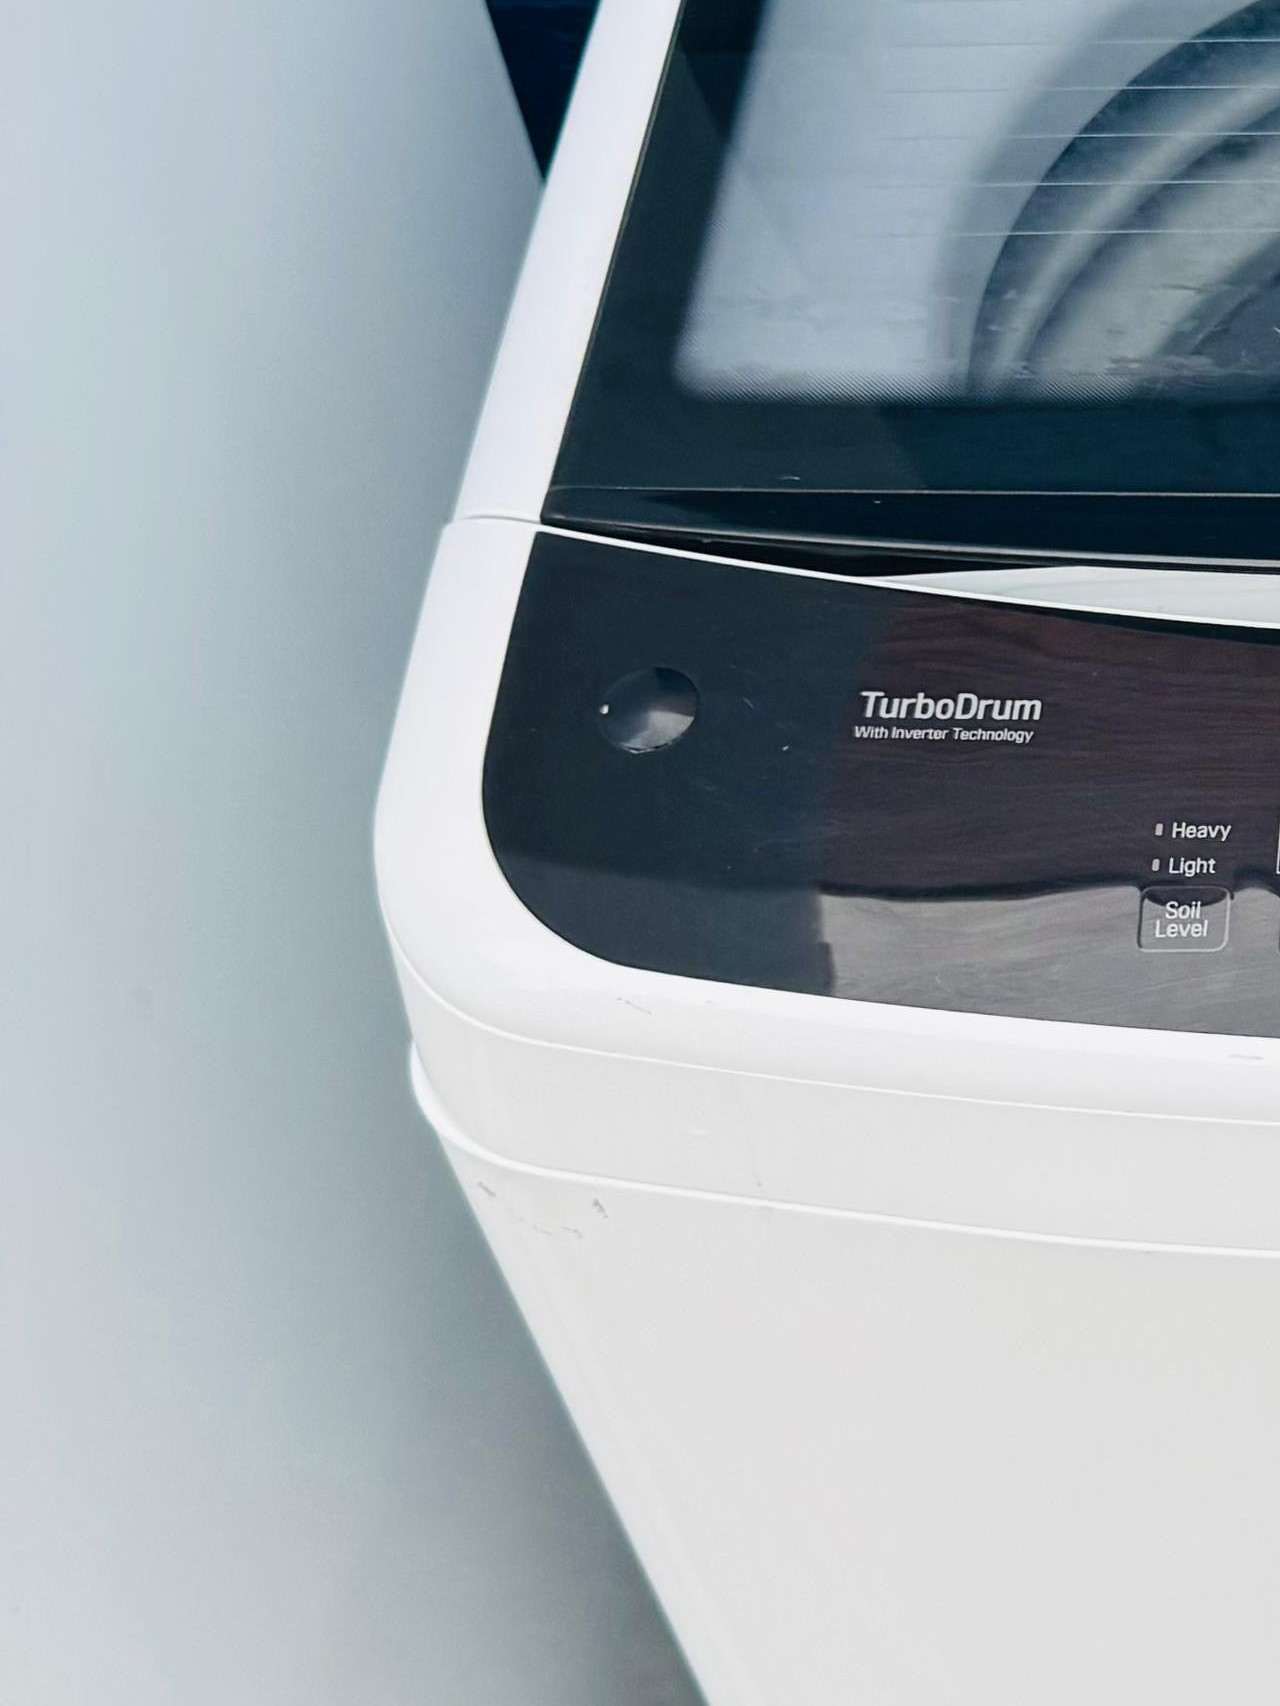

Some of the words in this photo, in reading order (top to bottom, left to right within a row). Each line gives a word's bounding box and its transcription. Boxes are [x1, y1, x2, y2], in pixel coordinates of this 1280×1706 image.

[860, 690, 1042, 721] TurboDrum
[854, 724, 888, 741] With
[891, 725, 949, 742] Inverter
[952, 726, 1034, 745] Technology
[1171, 822, 1232, 843] Heavy
[1168, 857, 1216, 877] Light
[1165, 901, 1202, 919] Soil
[1154, 920, 1209, 939] Level
